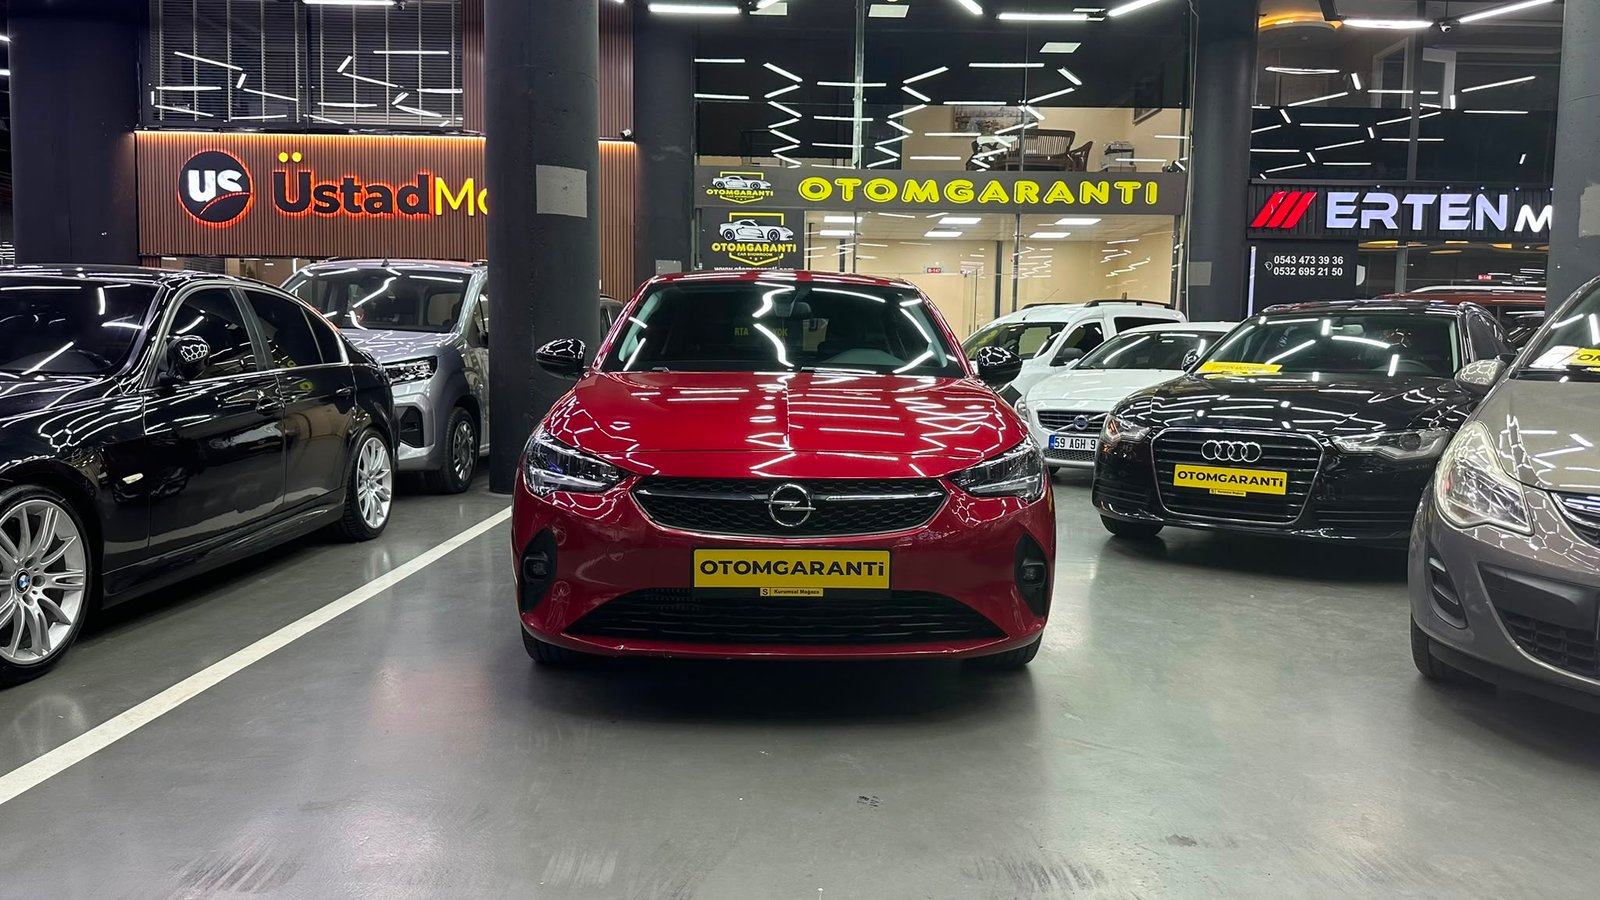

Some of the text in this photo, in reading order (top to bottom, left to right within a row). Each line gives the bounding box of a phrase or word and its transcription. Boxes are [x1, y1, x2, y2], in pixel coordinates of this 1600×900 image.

[798, 177, 1158, 204] OTOMGARANTI
[1326, 191, 1508, 231] ERTEN
[711, 242, 797, 253] OTOMGARANTI
[1274, 255, 1344, 265] 0543 473 39 36
[1273, 266, 1343, 276] 0532 695 21 50
[1054, 437, 1066, 448] 59
[1069, 438, 1086, 449] AGH
